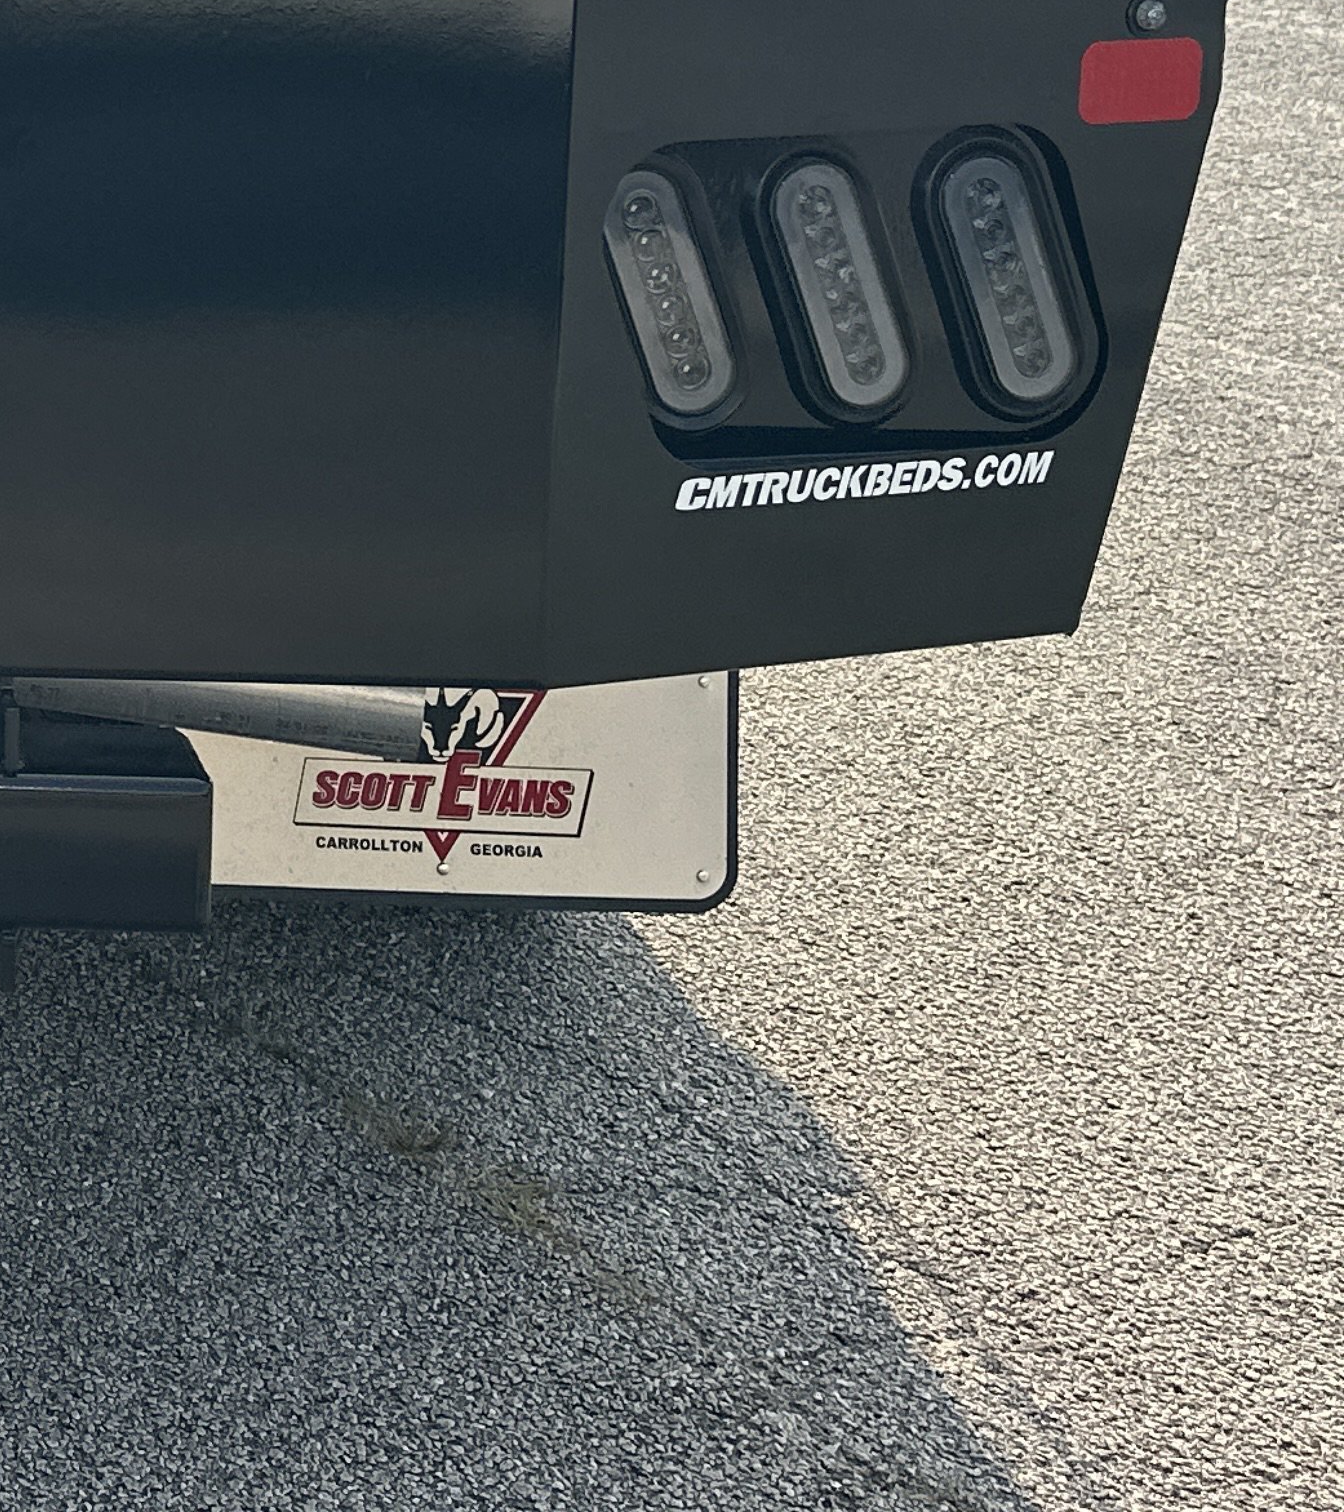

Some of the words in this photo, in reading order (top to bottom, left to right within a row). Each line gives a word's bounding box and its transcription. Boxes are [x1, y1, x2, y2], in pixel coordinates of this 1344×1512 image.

[674, 450, 1055, 511] CMTRUCKBEDS.COM
[312, 769, 436, 812] SCOTT
[436, 749, 576, 821] EVANS
[315, 836, 424, 854] CARROLLTON
[470, 843, 544, 859] GEORGIA
